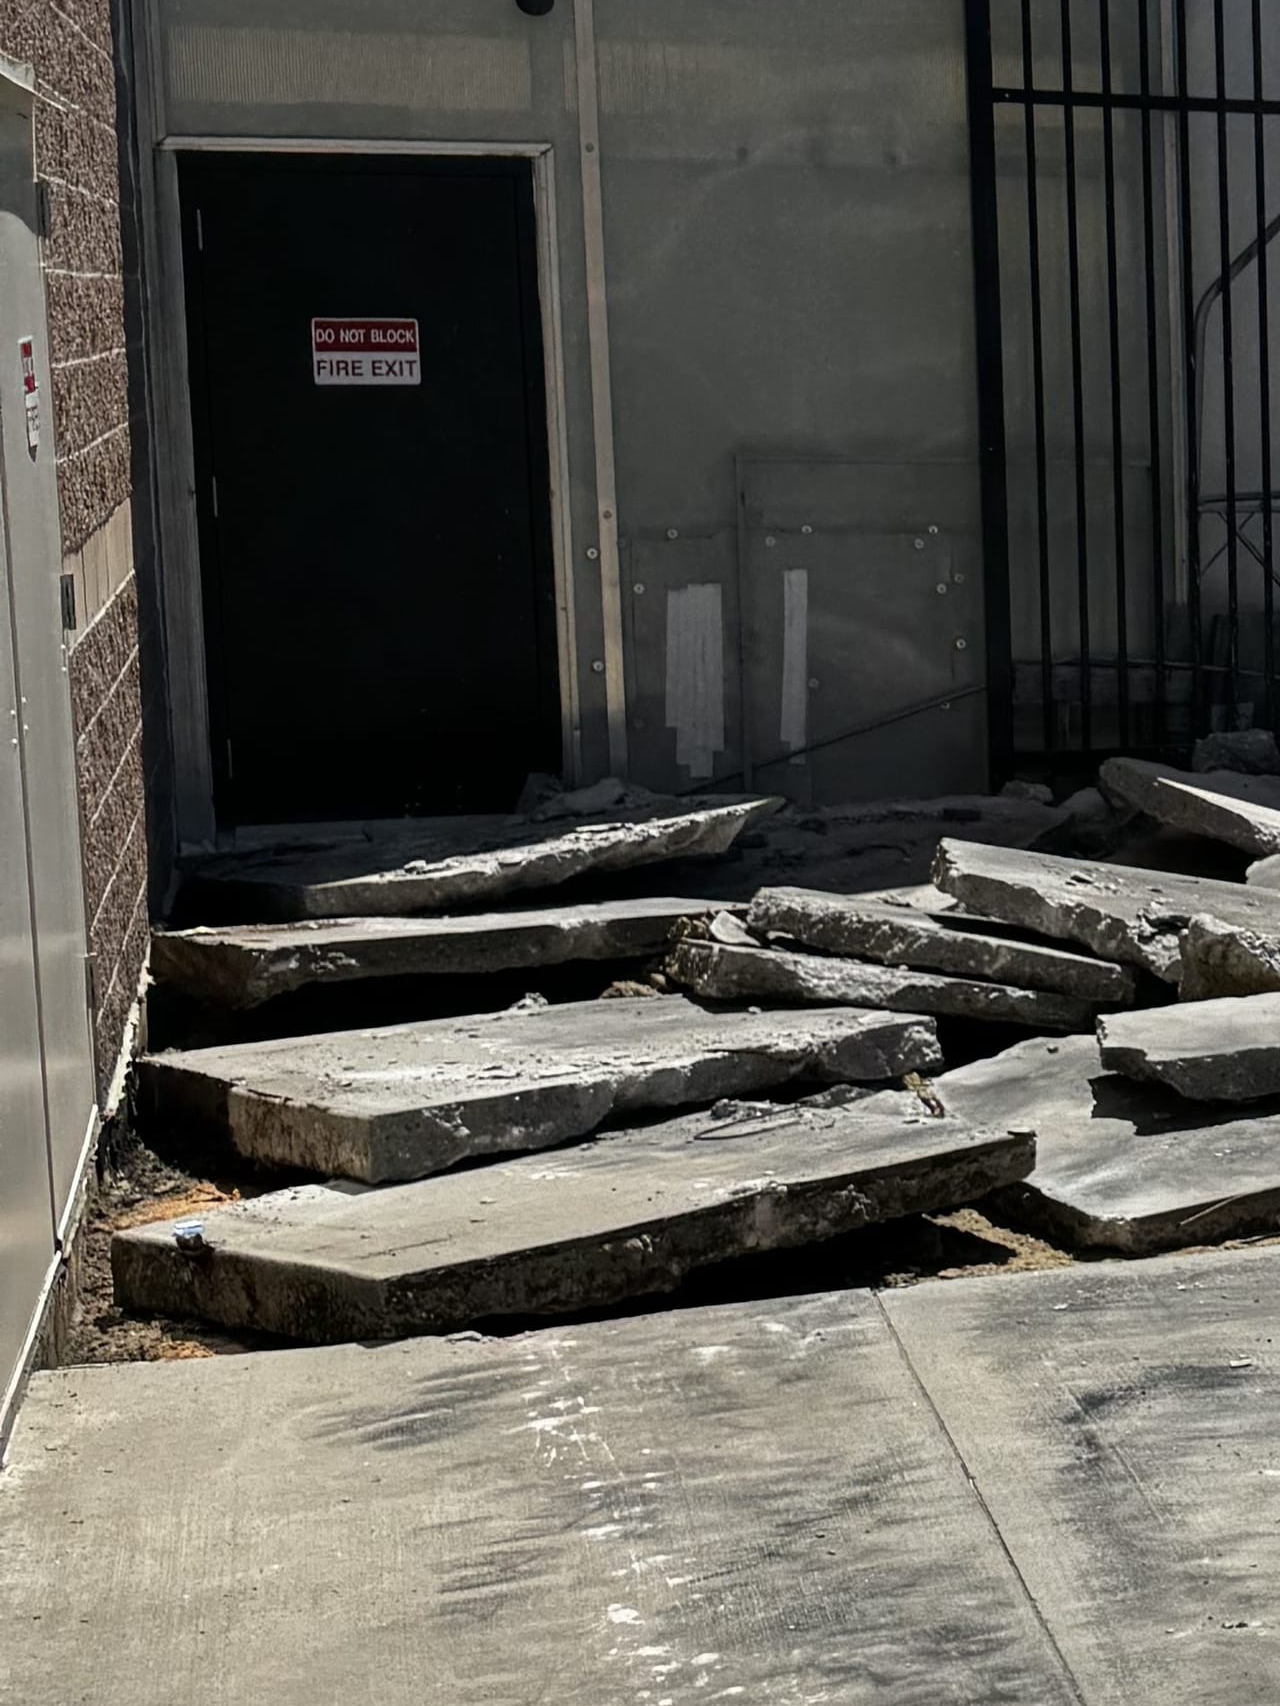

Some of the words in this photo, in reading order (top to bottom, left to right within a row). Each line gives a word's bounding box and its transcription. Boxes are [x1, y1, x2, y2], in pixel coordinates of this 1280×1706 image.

[315, 328, 335, 344] DO
[340, 328, 365, 344] NOT
[371, 328, 415, 344] BLOCK
[316, 359, 364, 377] FIRE
[371, 359, 417, 377] EXIT
